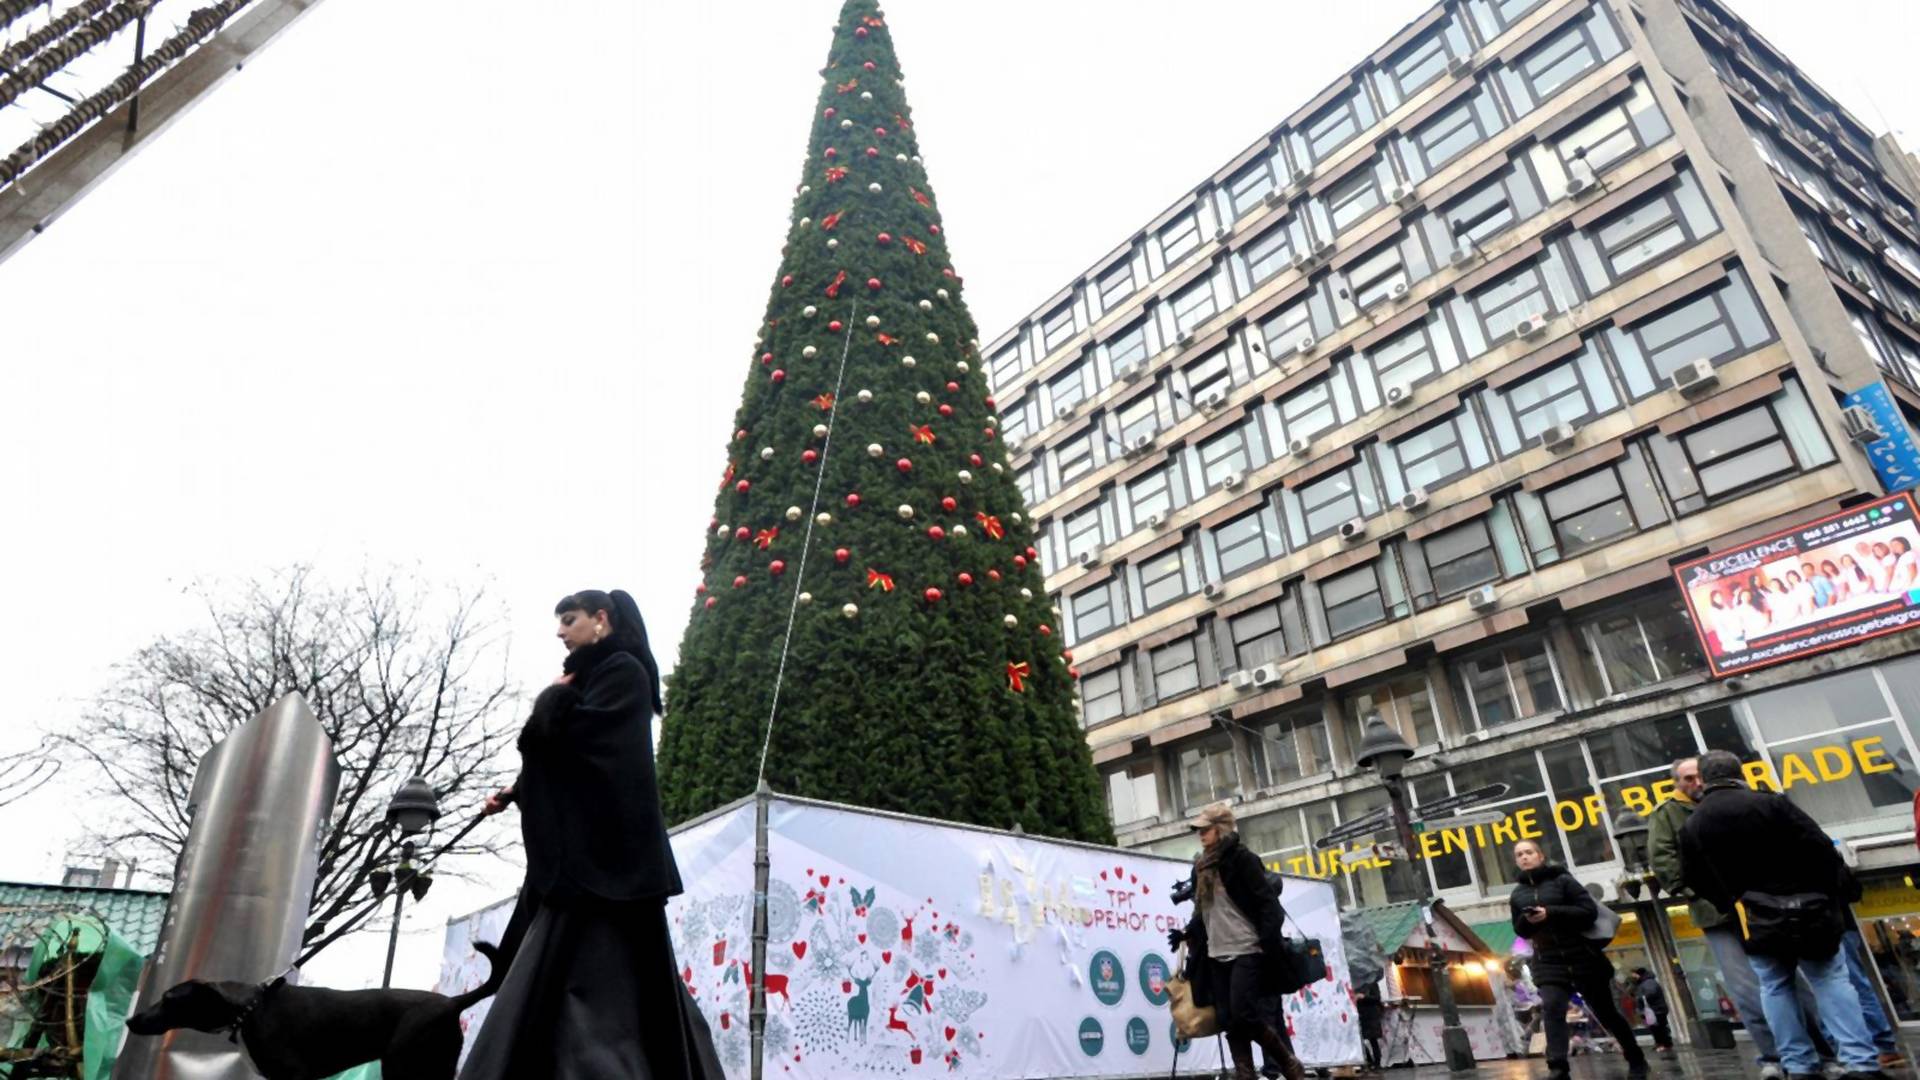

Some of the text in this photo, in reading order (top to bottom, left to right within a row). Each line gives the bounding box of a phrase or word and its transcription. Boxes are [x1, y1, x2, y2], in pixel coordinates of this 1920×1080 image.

[1709, 536, 1797, 573] EXCELLENCE
[1554, 793, 1606, 832] OF
[1106, 889, 1136, 909] ТРГ
